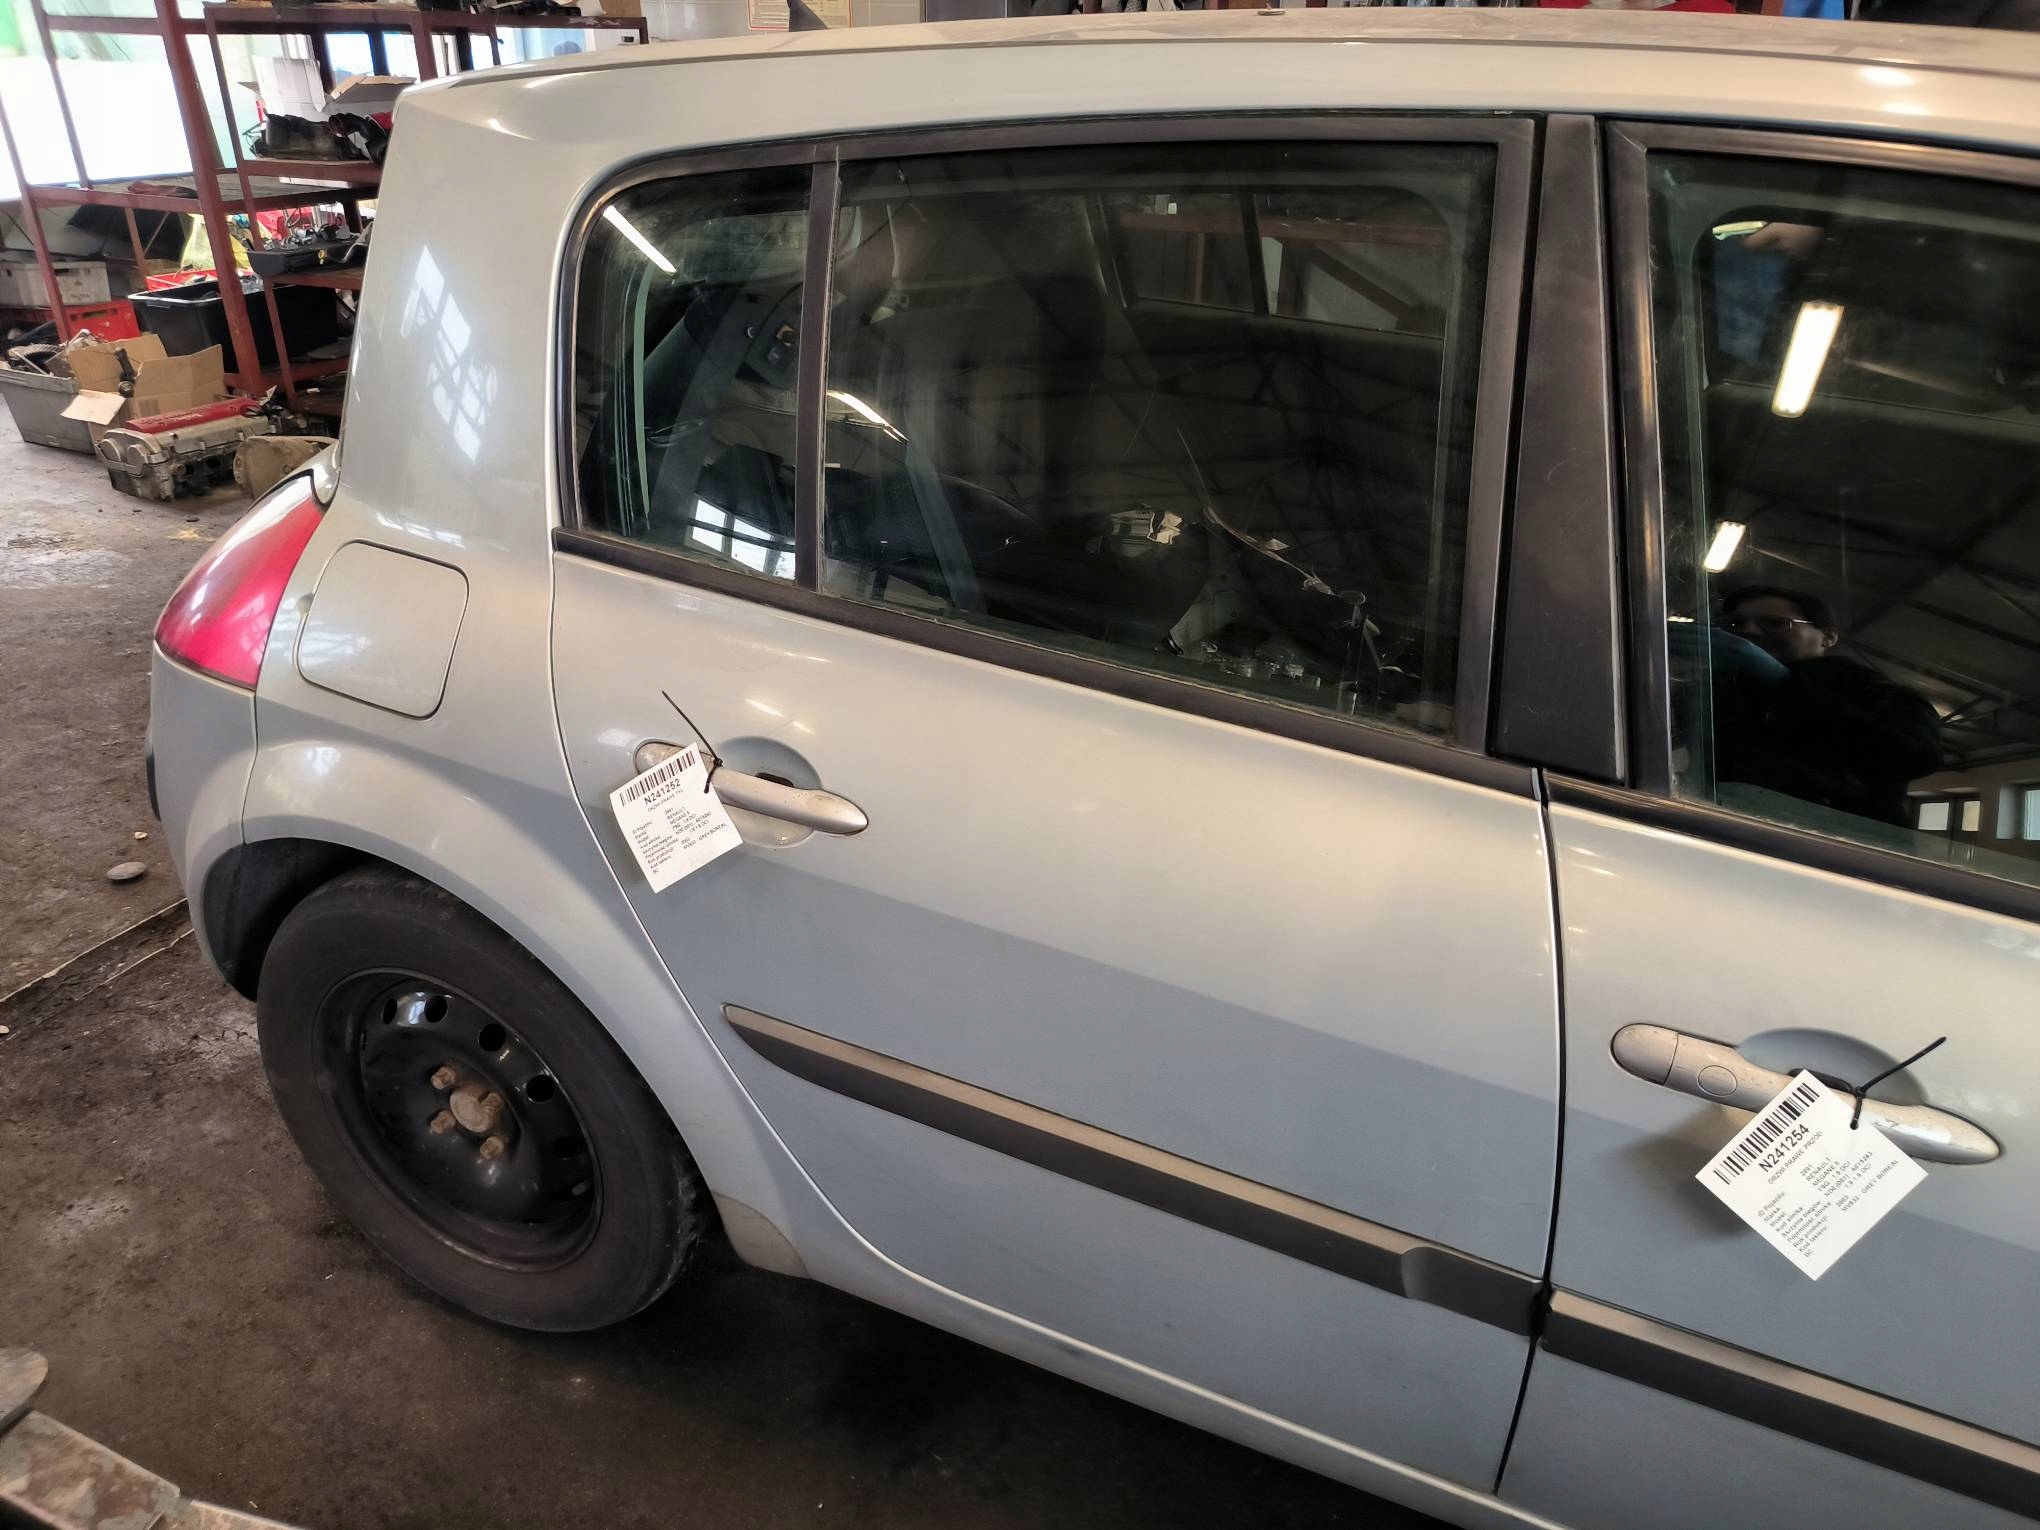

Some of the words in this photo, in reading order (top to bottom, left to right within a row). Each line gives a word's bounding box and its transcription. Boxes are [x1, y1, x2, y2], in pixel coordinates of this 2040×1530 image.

[644, 778, 681, 805] N241252
[1758, 1124, 1809, 1173] N241254
[1768, 1166, 1786, 1184] DRZWI
[1784, 1148, 1804, 1168] PRAWE
[1806, 1157, 1831, 1182] RENAULT
[1812, 1165, 1835, 1186] MEGANE
